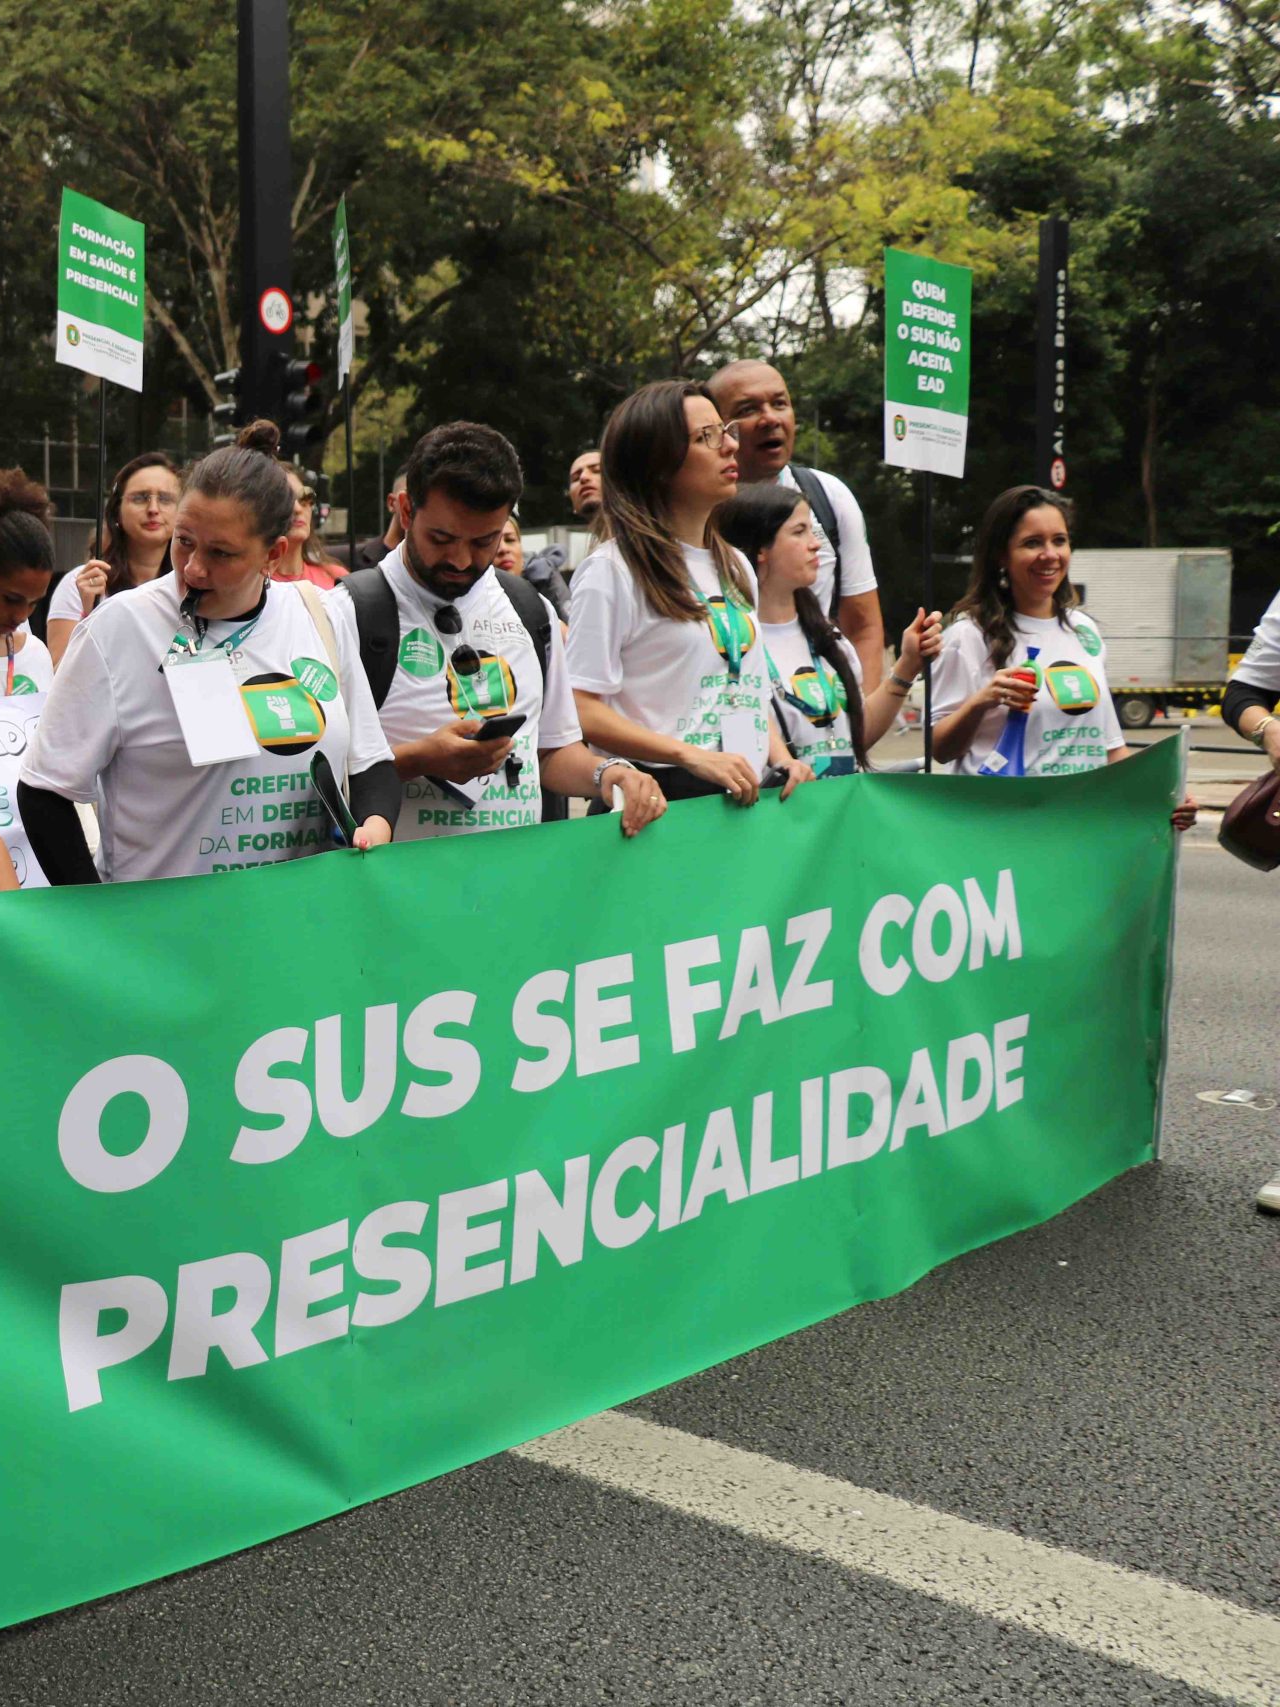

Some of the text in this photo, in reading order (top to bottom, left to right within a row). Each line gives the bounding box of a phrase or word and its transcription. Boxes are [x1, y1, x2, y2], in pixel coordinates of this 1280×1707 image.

[72, 222, 136, 259] FORMAÇÃO
[69, 245, 136, 283] EM SAÚDE É
[66, 268, 138, 307] PRESENCIAL!
[912, 280, 946, 303] QUEM
[902, 300, 956, 328] DEFENDE
[897, 323, 961, 352] O SUS NÃO
[907, 350, 953, 373] ACEITA
[917, 375, 945, 393] EAD
[230, 772, 310, 796] CREFIT
[406, 783, 435, 799] DA
[221, 800, 320, 825] EM DEFE
[418, 808, 536, 826] PRESENCIAL
[199, 828, 319, 856] DA FORMA
[58, 869, 1023, 1193] O SUS SE FAZ COM
[59, 1014, 1030, 1412] PRESENCIALIDADE
